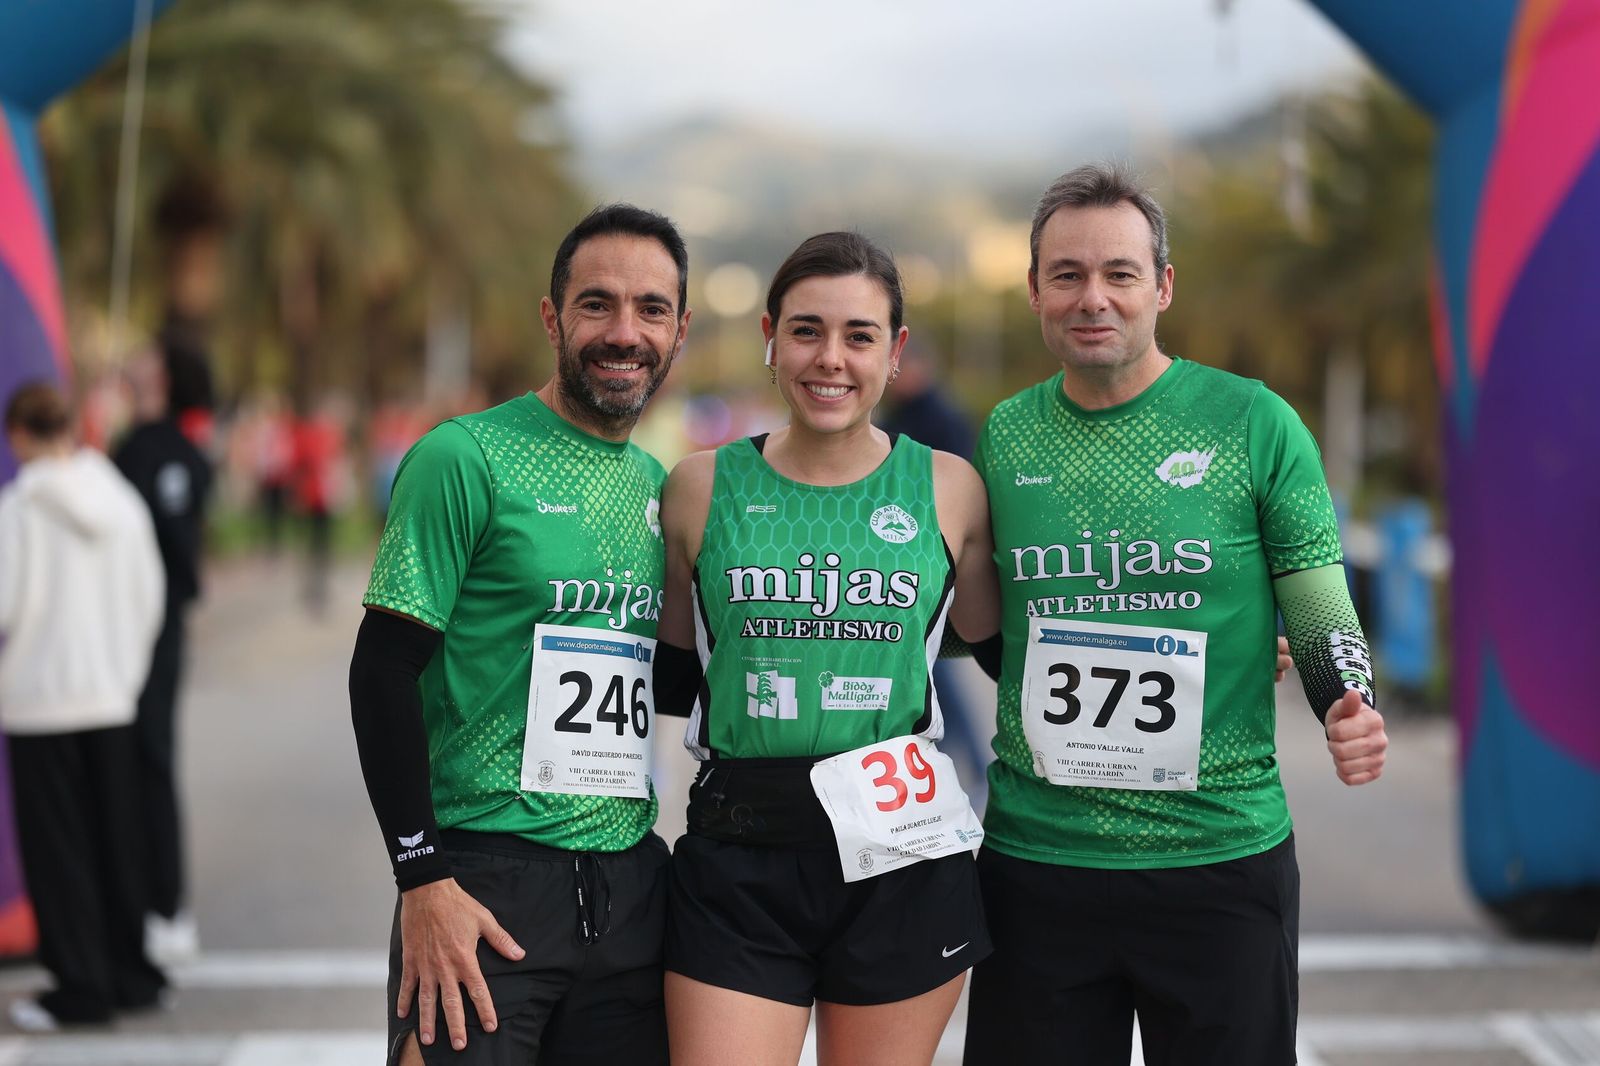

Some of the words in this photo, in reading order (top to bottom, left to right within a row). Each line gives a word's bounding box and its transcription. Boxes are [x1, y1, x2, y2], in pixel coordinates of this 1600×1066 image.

[1167, 461, 1195, 476] 40
[871, 510, 883, 526] CLUB
[1010, 528, 1214, 590] mijas
[725, 553, 919, 617] mijas
[1025, 590, 1202, 617] ATLETISMO
[740, 618, 903, 642] ATLETISMO
[556, 640, 623, 653] www.deporte.malaga.eu
[1045, 633, 1128, 646] www.deporte.malaga.eu
[842, 681, 875, 693] Biddy
[828, 691, 888, 703] Mulligan's
[1043, 663, 1176, 733] 373
[554, 671, 649, 739] 246
[1066, 741, 1096, 751] ANTONIO
[1097, 744, 1120, 752] VALLE
[1121, 745, 1145, 754] VALLE
[591, 751, 621, 759] IZQUIERDO
[622, 752, 643, 760] PAREDES
[582, 768, 612, 776] CARRERA
[1057, 758, 1069, 766] VIII
[1070, 760, 1105, 769] CARRERA
[1107, 762, 1137, 771] URBANA
[1067, 767, 1096, 775] CIUDAD
[579, 776, 604, 784] CIUDAD
[861, 742, 936, 812] 39
[900, 838, 923, 850] CARRERA
[924, 832, 945, 842] URBANA
[397, 845, 434, 862] erima
